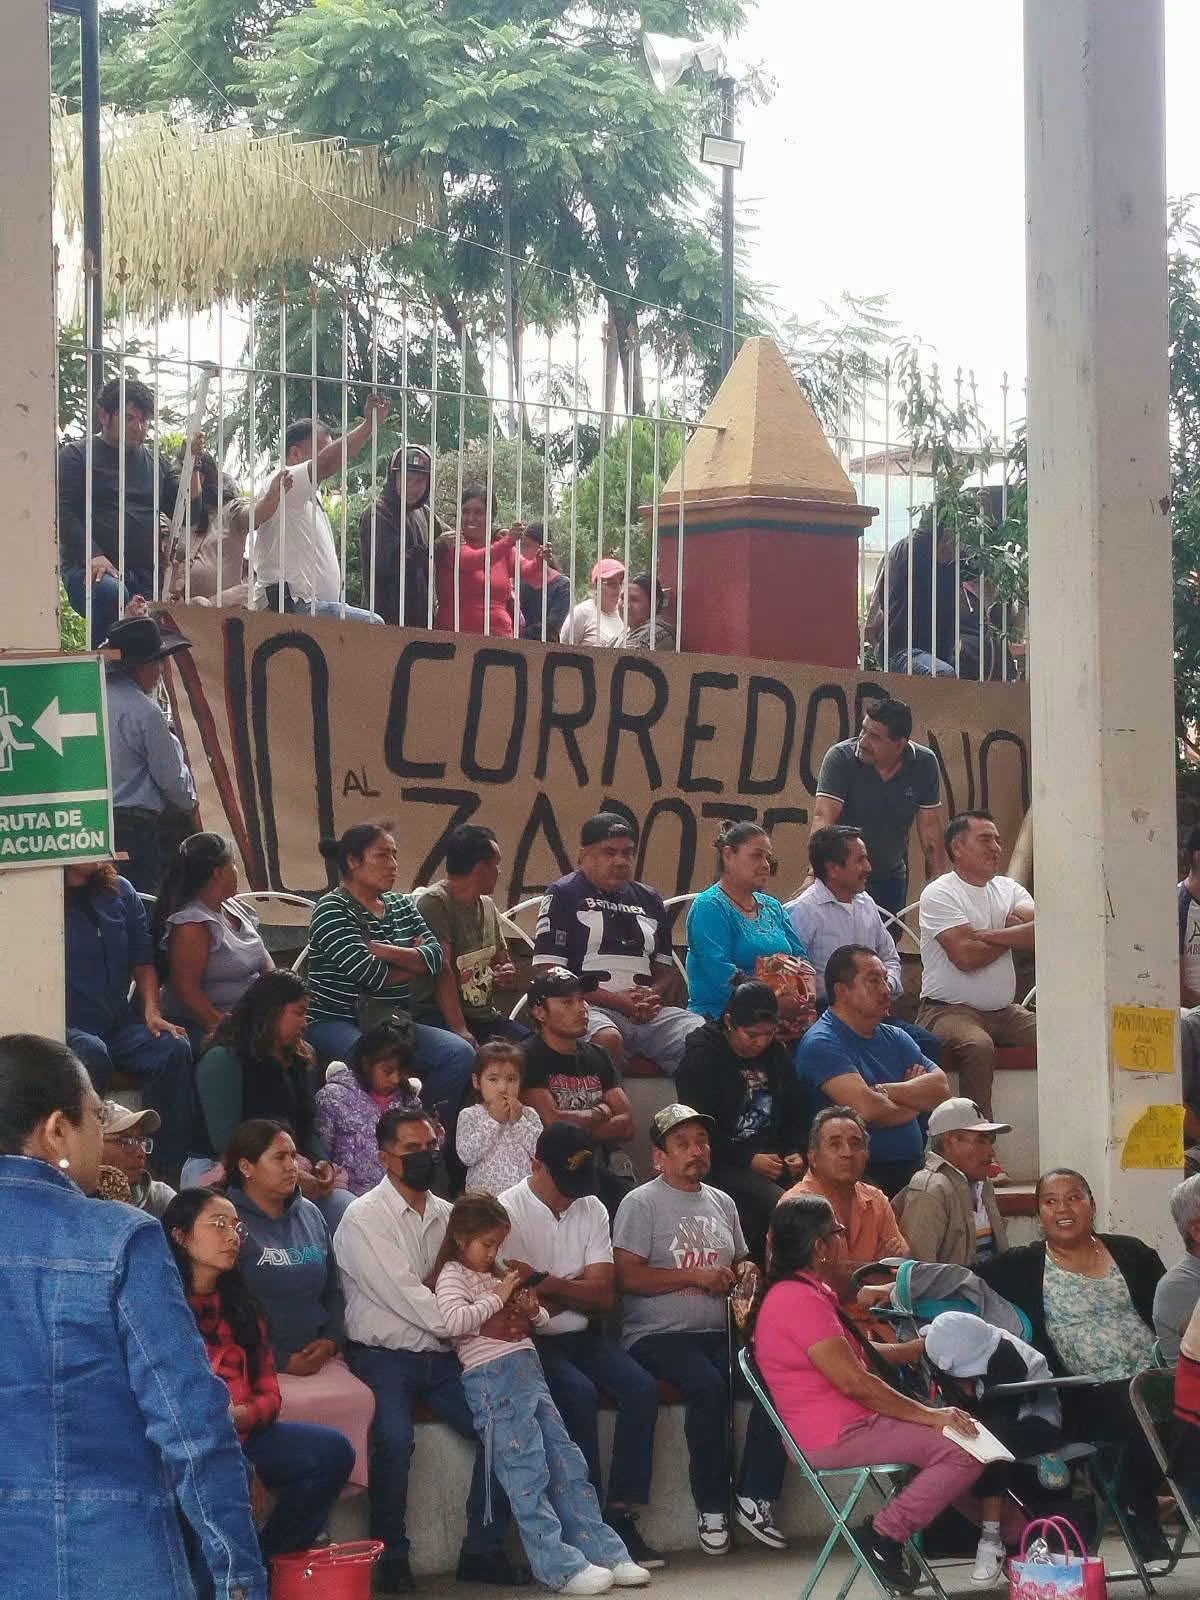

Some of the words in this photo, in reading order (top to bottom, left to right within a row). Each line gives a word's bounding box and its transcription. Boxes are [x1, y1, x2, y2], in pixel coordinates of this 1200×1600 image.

[343, 767, 382, 797] AL
[0, 811, 51, 832] RUTA
[54, 809, 82, 828] DE
[0, 827, 104, 855] ACUACIÓN
